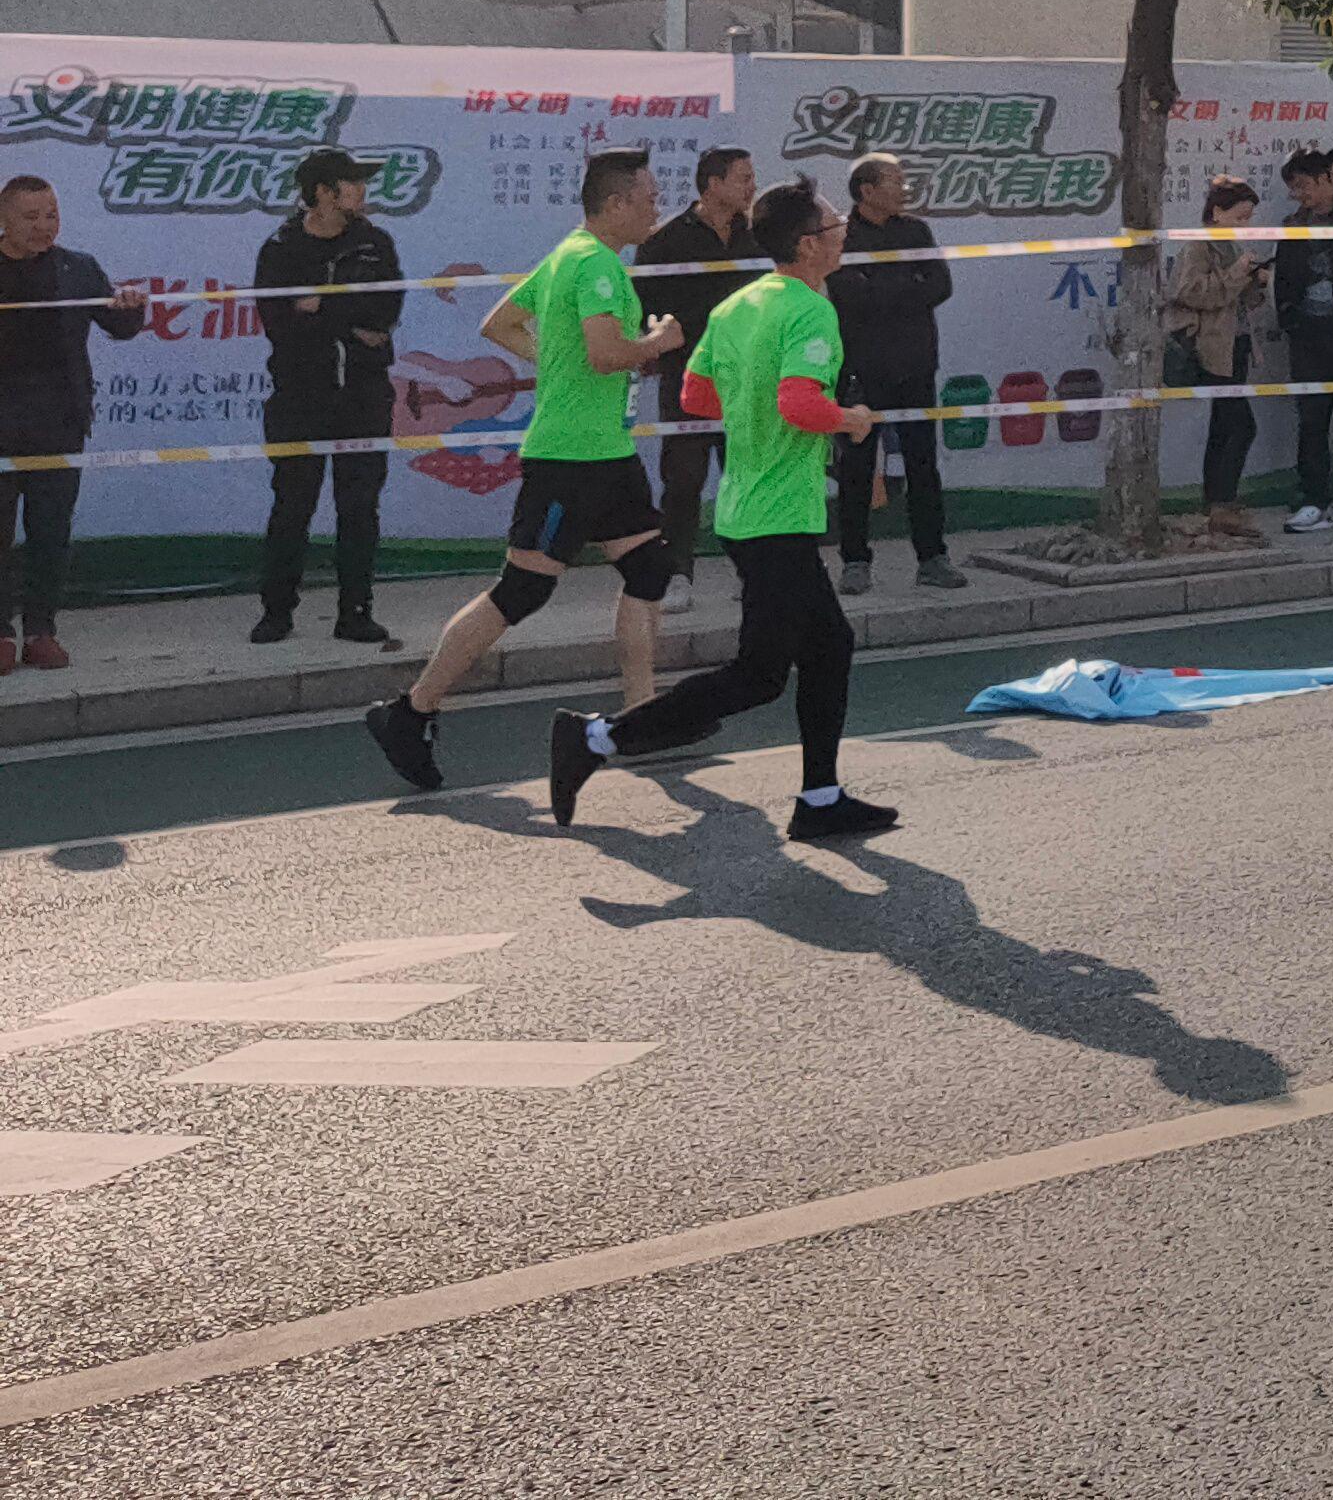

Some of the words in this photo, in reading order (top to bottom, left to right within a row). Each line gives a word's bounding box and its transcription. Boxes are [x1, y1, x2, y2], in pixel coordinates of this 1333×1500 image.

[4, 68, 338, 134] 文明健康
[792, 89, 1041, 145] 文明健康
[115, 148, 421, 202] 有你我
